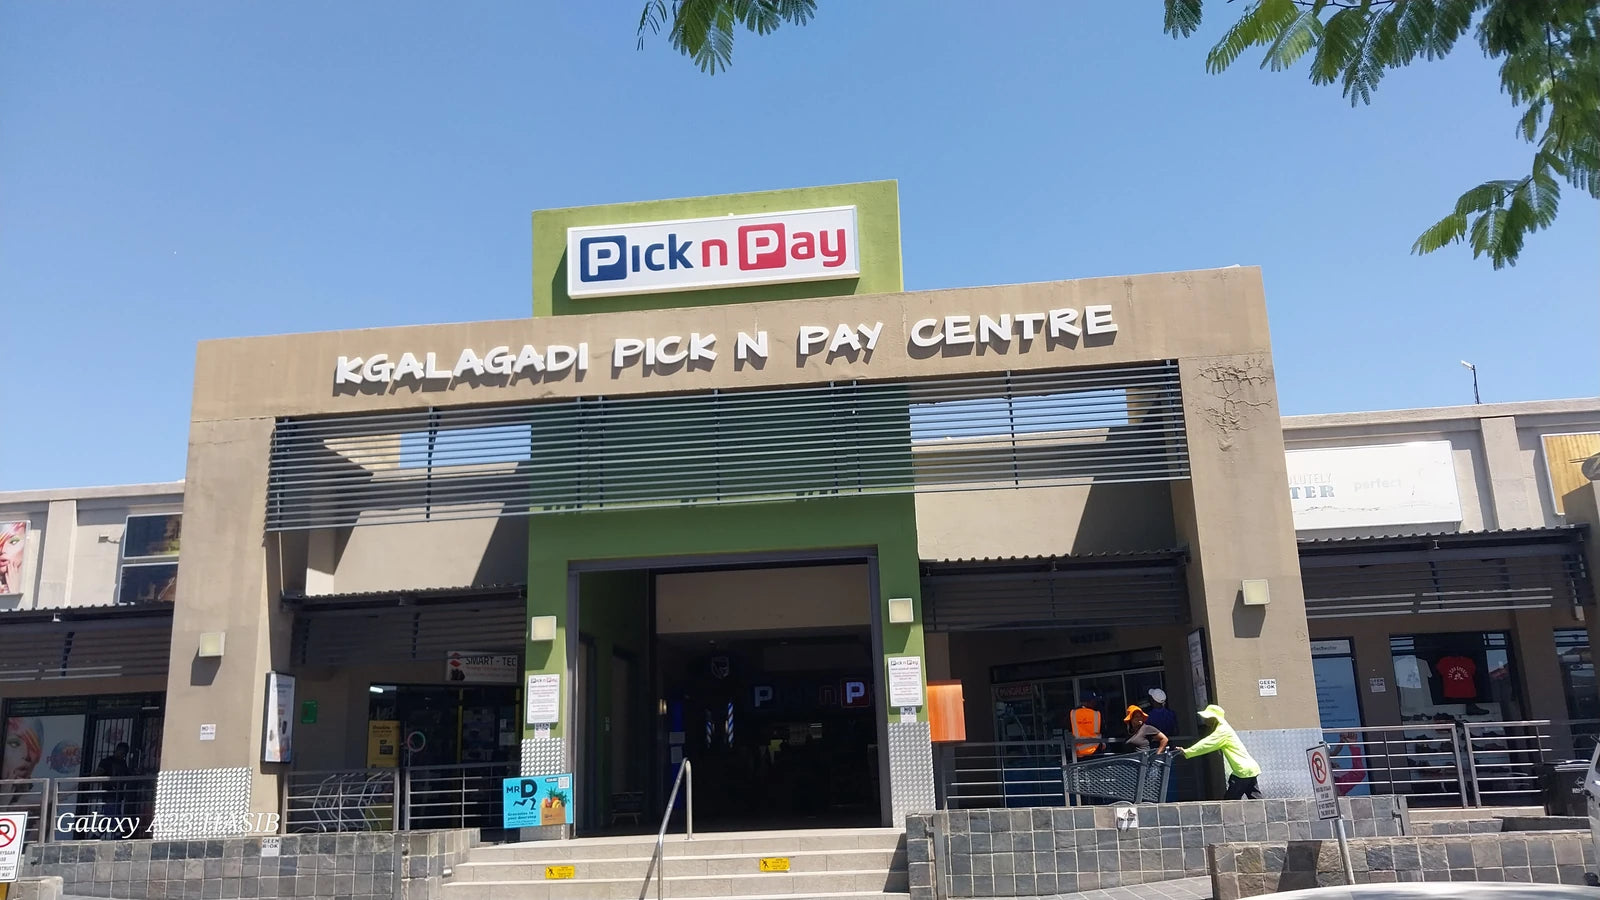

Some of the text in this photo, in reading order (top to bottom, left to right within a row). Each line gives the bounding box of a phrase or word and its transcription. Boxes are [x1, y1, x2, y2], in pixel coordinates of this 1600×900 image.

[580, 222, 847, 282] Pick n Pay
[335, 304, 1119, 384] KGALAGADI PICK N PAY CENTRE
[465, 655, 494, 666] SMART
[502, 656, 517, 667] TEC
[506, 778, 538, 799] MR D
